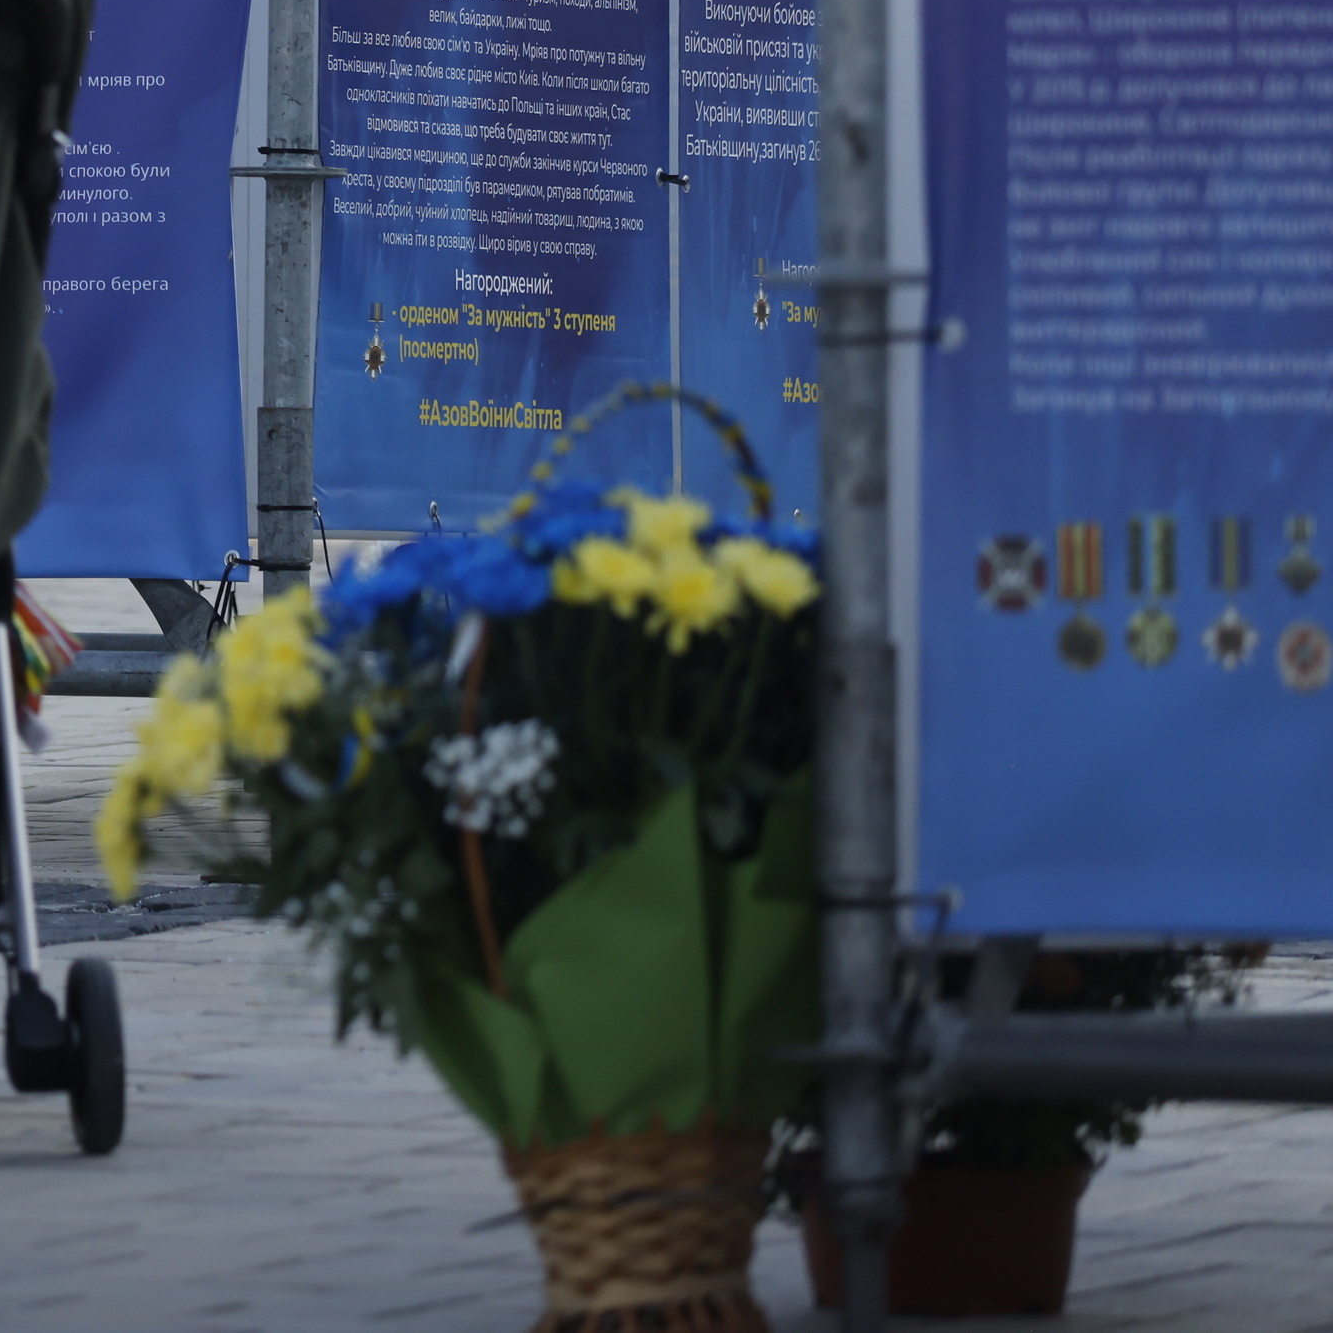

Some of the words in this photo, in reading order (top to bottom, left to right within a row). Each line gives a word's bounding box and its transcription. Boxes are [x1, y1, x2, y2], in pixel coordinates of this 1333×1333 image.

[706, 0, 770, 27] Виконуючи
[774, 2, 815, 26] бойове
[685, 30, 742, 55] військовій
[746, 36, 789, 61] присязі
[792, 42, 803, 59] та
[136, 74, 165, 89] про
[681, 66, 762, 95] територіальну
[695, 100, 743, 127] України,
[746, 108, 805, 126] виявивши
[69, 165, 126, 177] спокою
[130, 162, 170, 180] були
[50, 211, 88, 225] уполі
[101, 210, 152, 225] разом
[157, 210, 166, 221] з
[383, 233, 413, 245] можна
[416, 234, 427, 246] іти
[437, 236, 475, 253] розвідку.
[479, 234, 505, 254] Щиро
[507, 235, 531, 255] вірив
[540, 241, 562, 254] свою
[565, 243, 597, 259] справу.
[42, 278, 106, 294] правого
[111, 275, 169, 293] берега
[456, 269, 552, 296] Нагороджений:
[400, 306, 458, 328] орденом
[554, 308, 561, 329] 3
[564, 313, 615, 336] ступеня
[400, 335, 478, 365] (посмертно)
[783, 377, 819, 404] #Азо
[420, 399, 562, 429] #АзовВоїниСвітла
